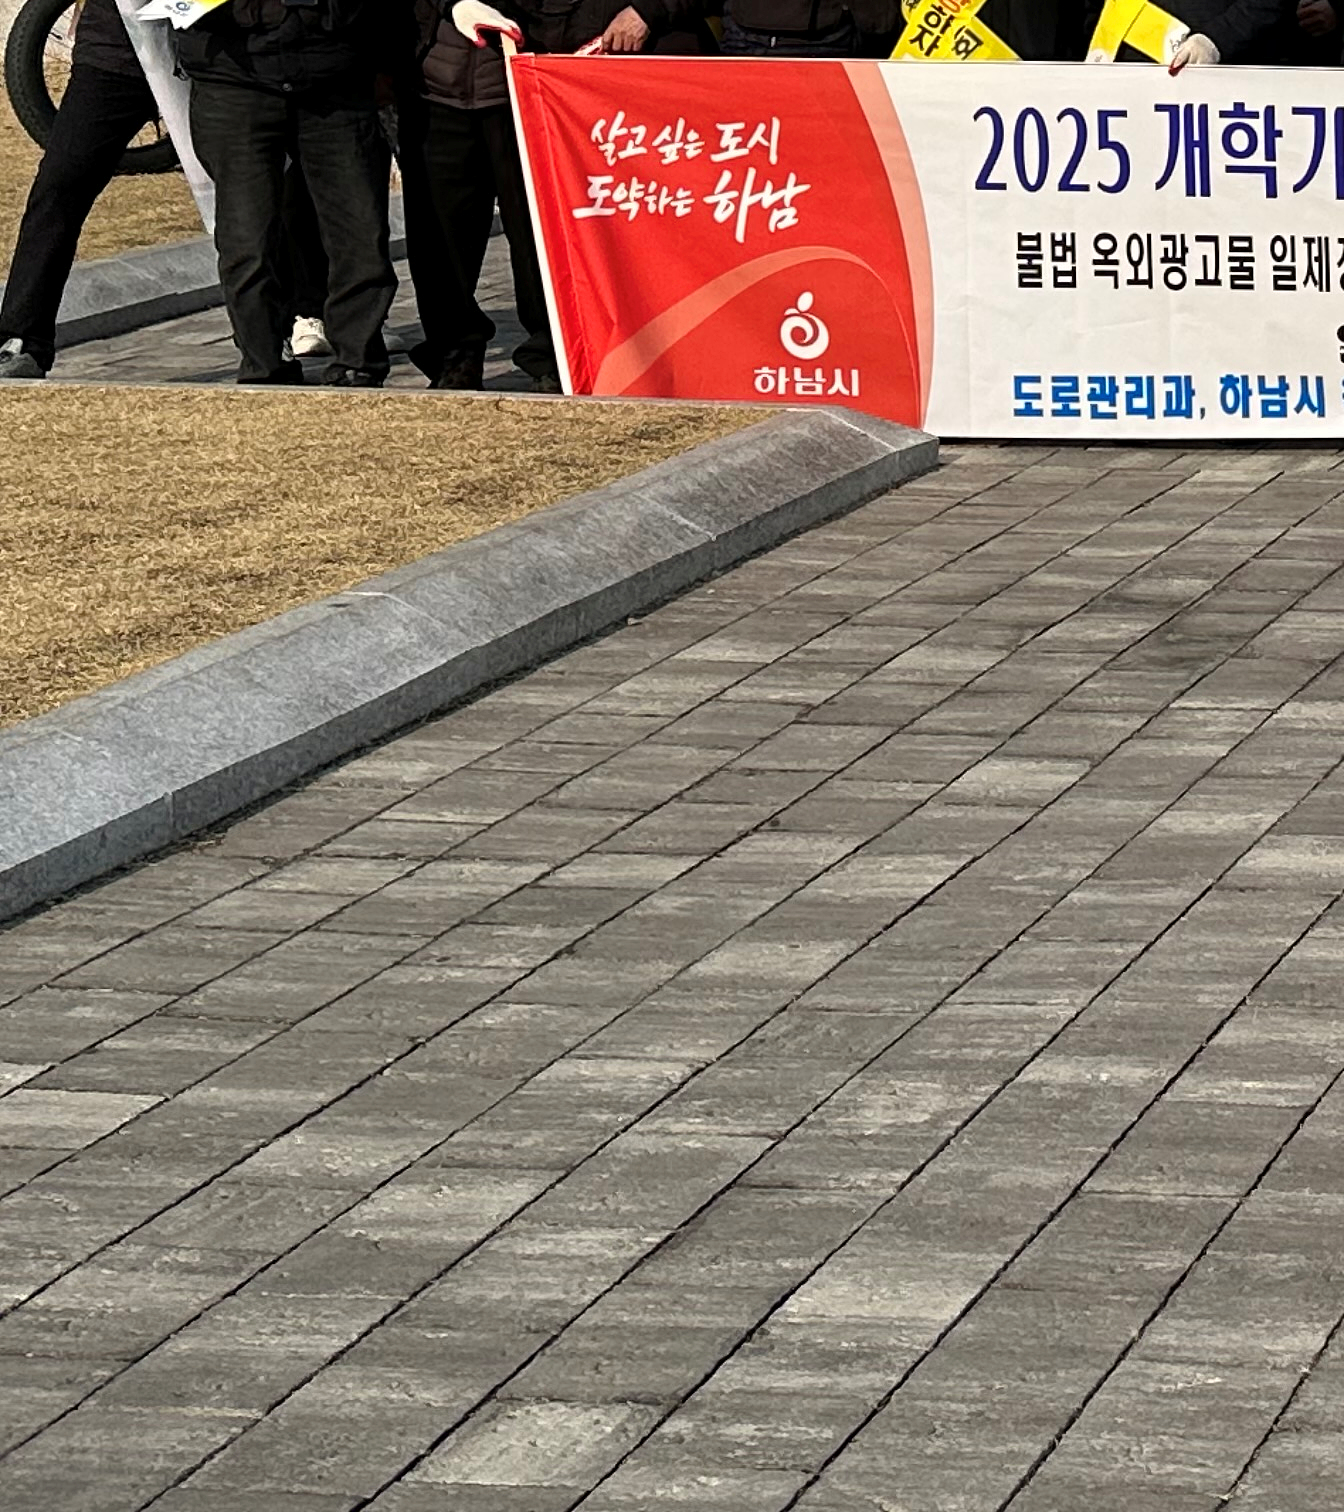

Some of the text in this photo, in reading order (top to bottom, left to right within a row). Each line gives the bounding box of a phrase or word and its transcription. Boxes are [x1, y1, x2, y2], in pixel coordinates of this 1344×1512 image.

[709, 115, 782, 165] 도시
[972, 105, 1131, 194] 2025
[572, 167, 811, 243] 도약하는 하남
[1015, 231, 1078, 289] 불법
[1091, 232, 1256, 292] 옥외광고물
[753, 366, 860, 396] 하남시
[1013, 374, 1206, 421] 도로관리과,
[1219, 375, 1326, 419] 하남시
